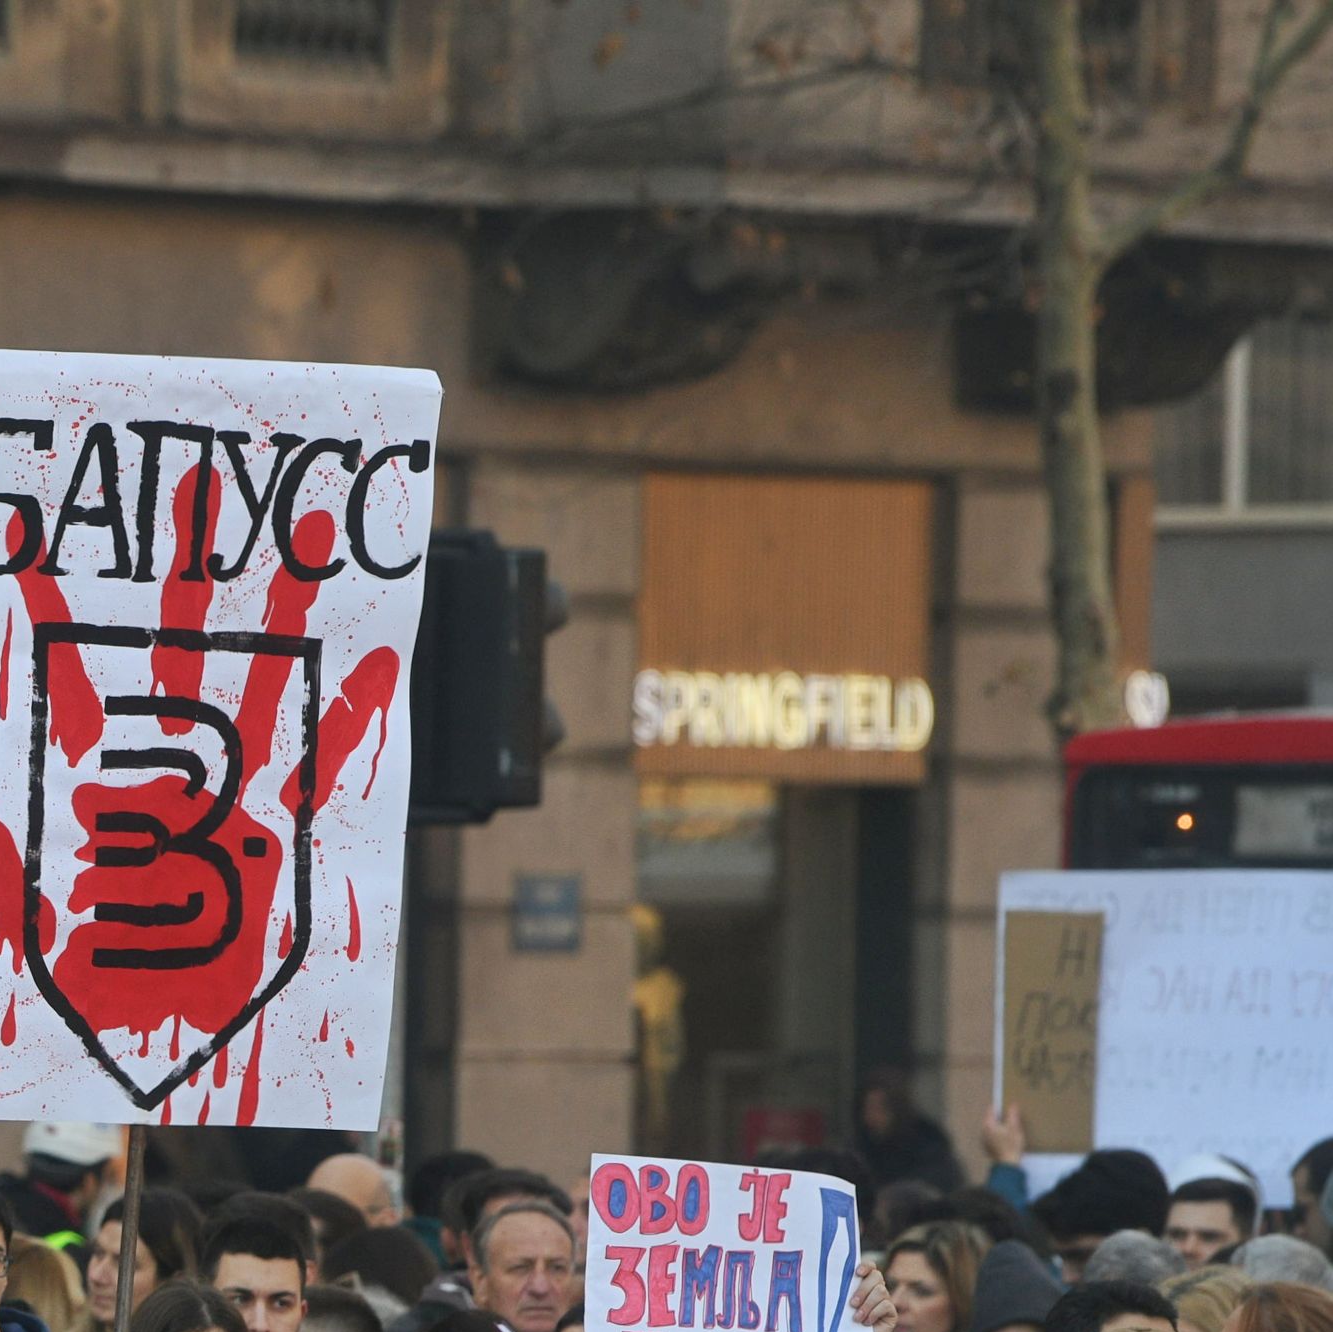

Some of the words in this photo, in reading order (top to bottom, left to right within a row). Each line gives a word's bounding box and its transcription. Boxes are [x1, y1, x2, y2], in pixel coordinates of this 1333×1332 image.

[632, 668, 934, 752] SPRINGFIELD
[591, 1162, 710, 1236] ОВО
[737, 1168, 792, 1243] ЈЕ
